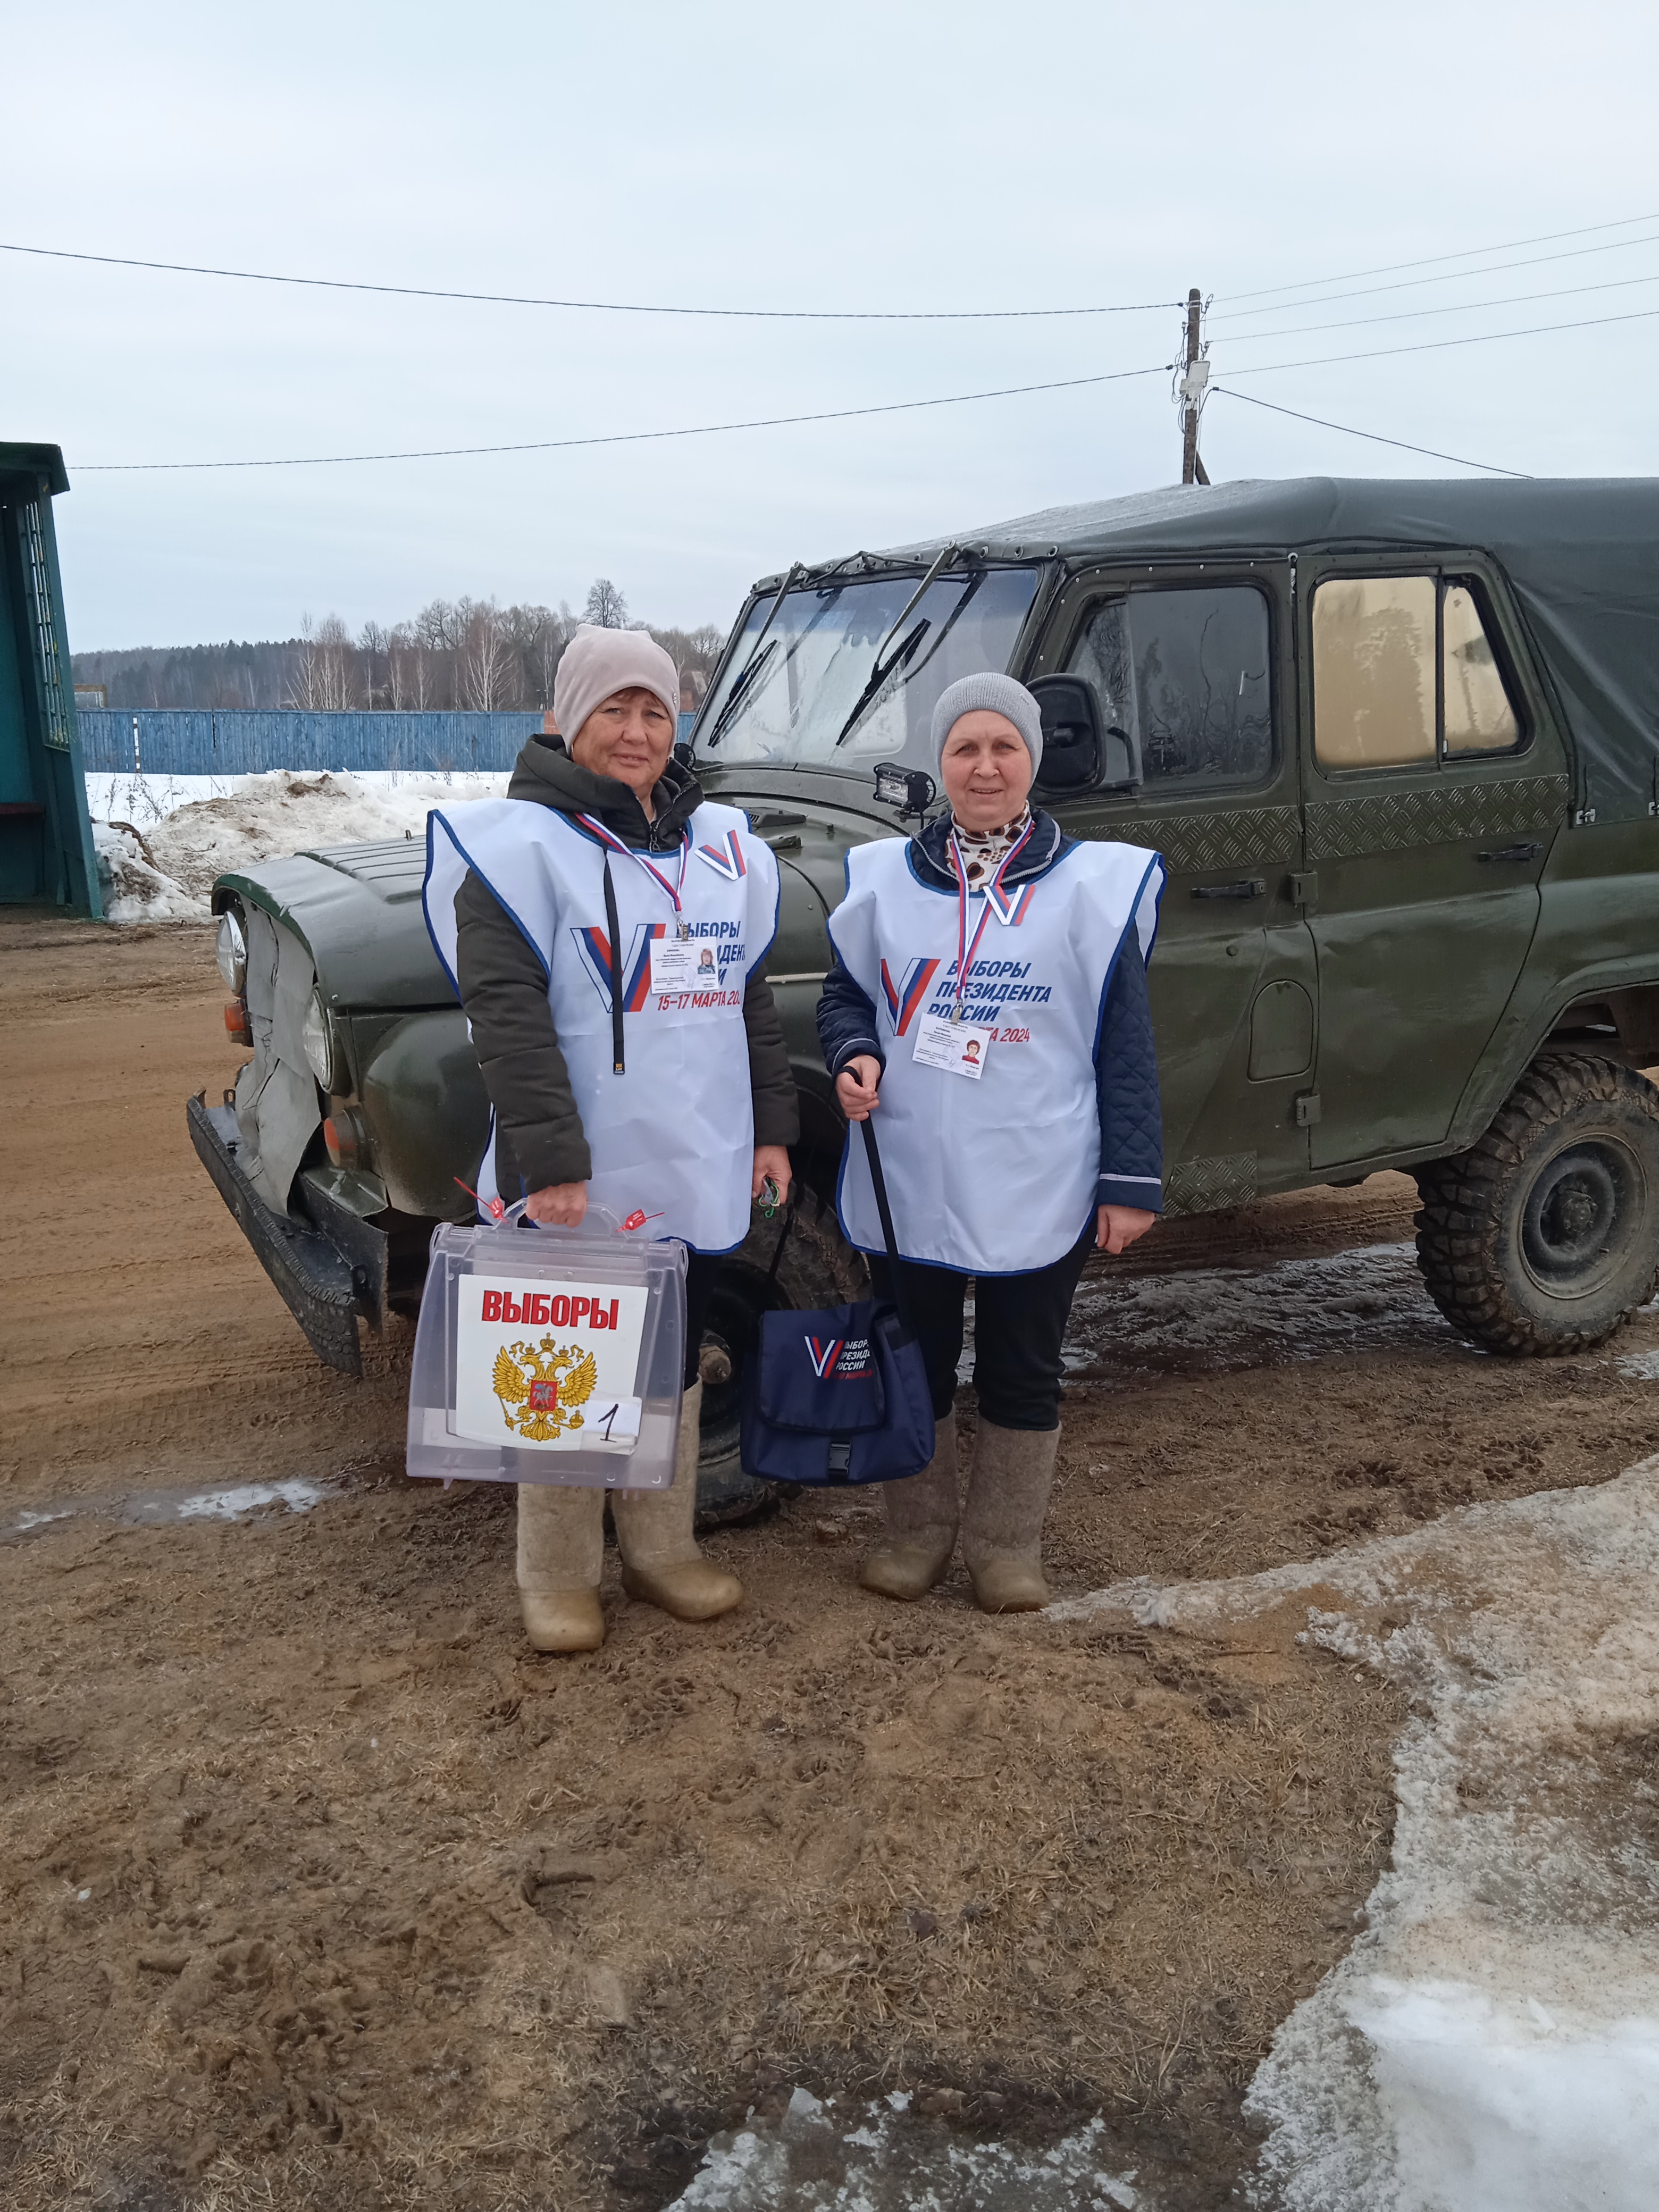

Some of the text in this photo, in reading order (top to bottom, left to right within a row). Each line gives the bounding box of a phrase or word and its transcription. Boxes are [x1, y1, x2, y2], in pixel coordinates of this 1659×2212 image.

[691, 991, 726, 1009] МАРТА
[999, 1027, 1030, 1043] 2024
[481, 1290, 619, 1330] ВЫБОРЫ
[844, 1339, 869, 1350] ВЫБОР
[598, 1403, 617, 1443] 1
